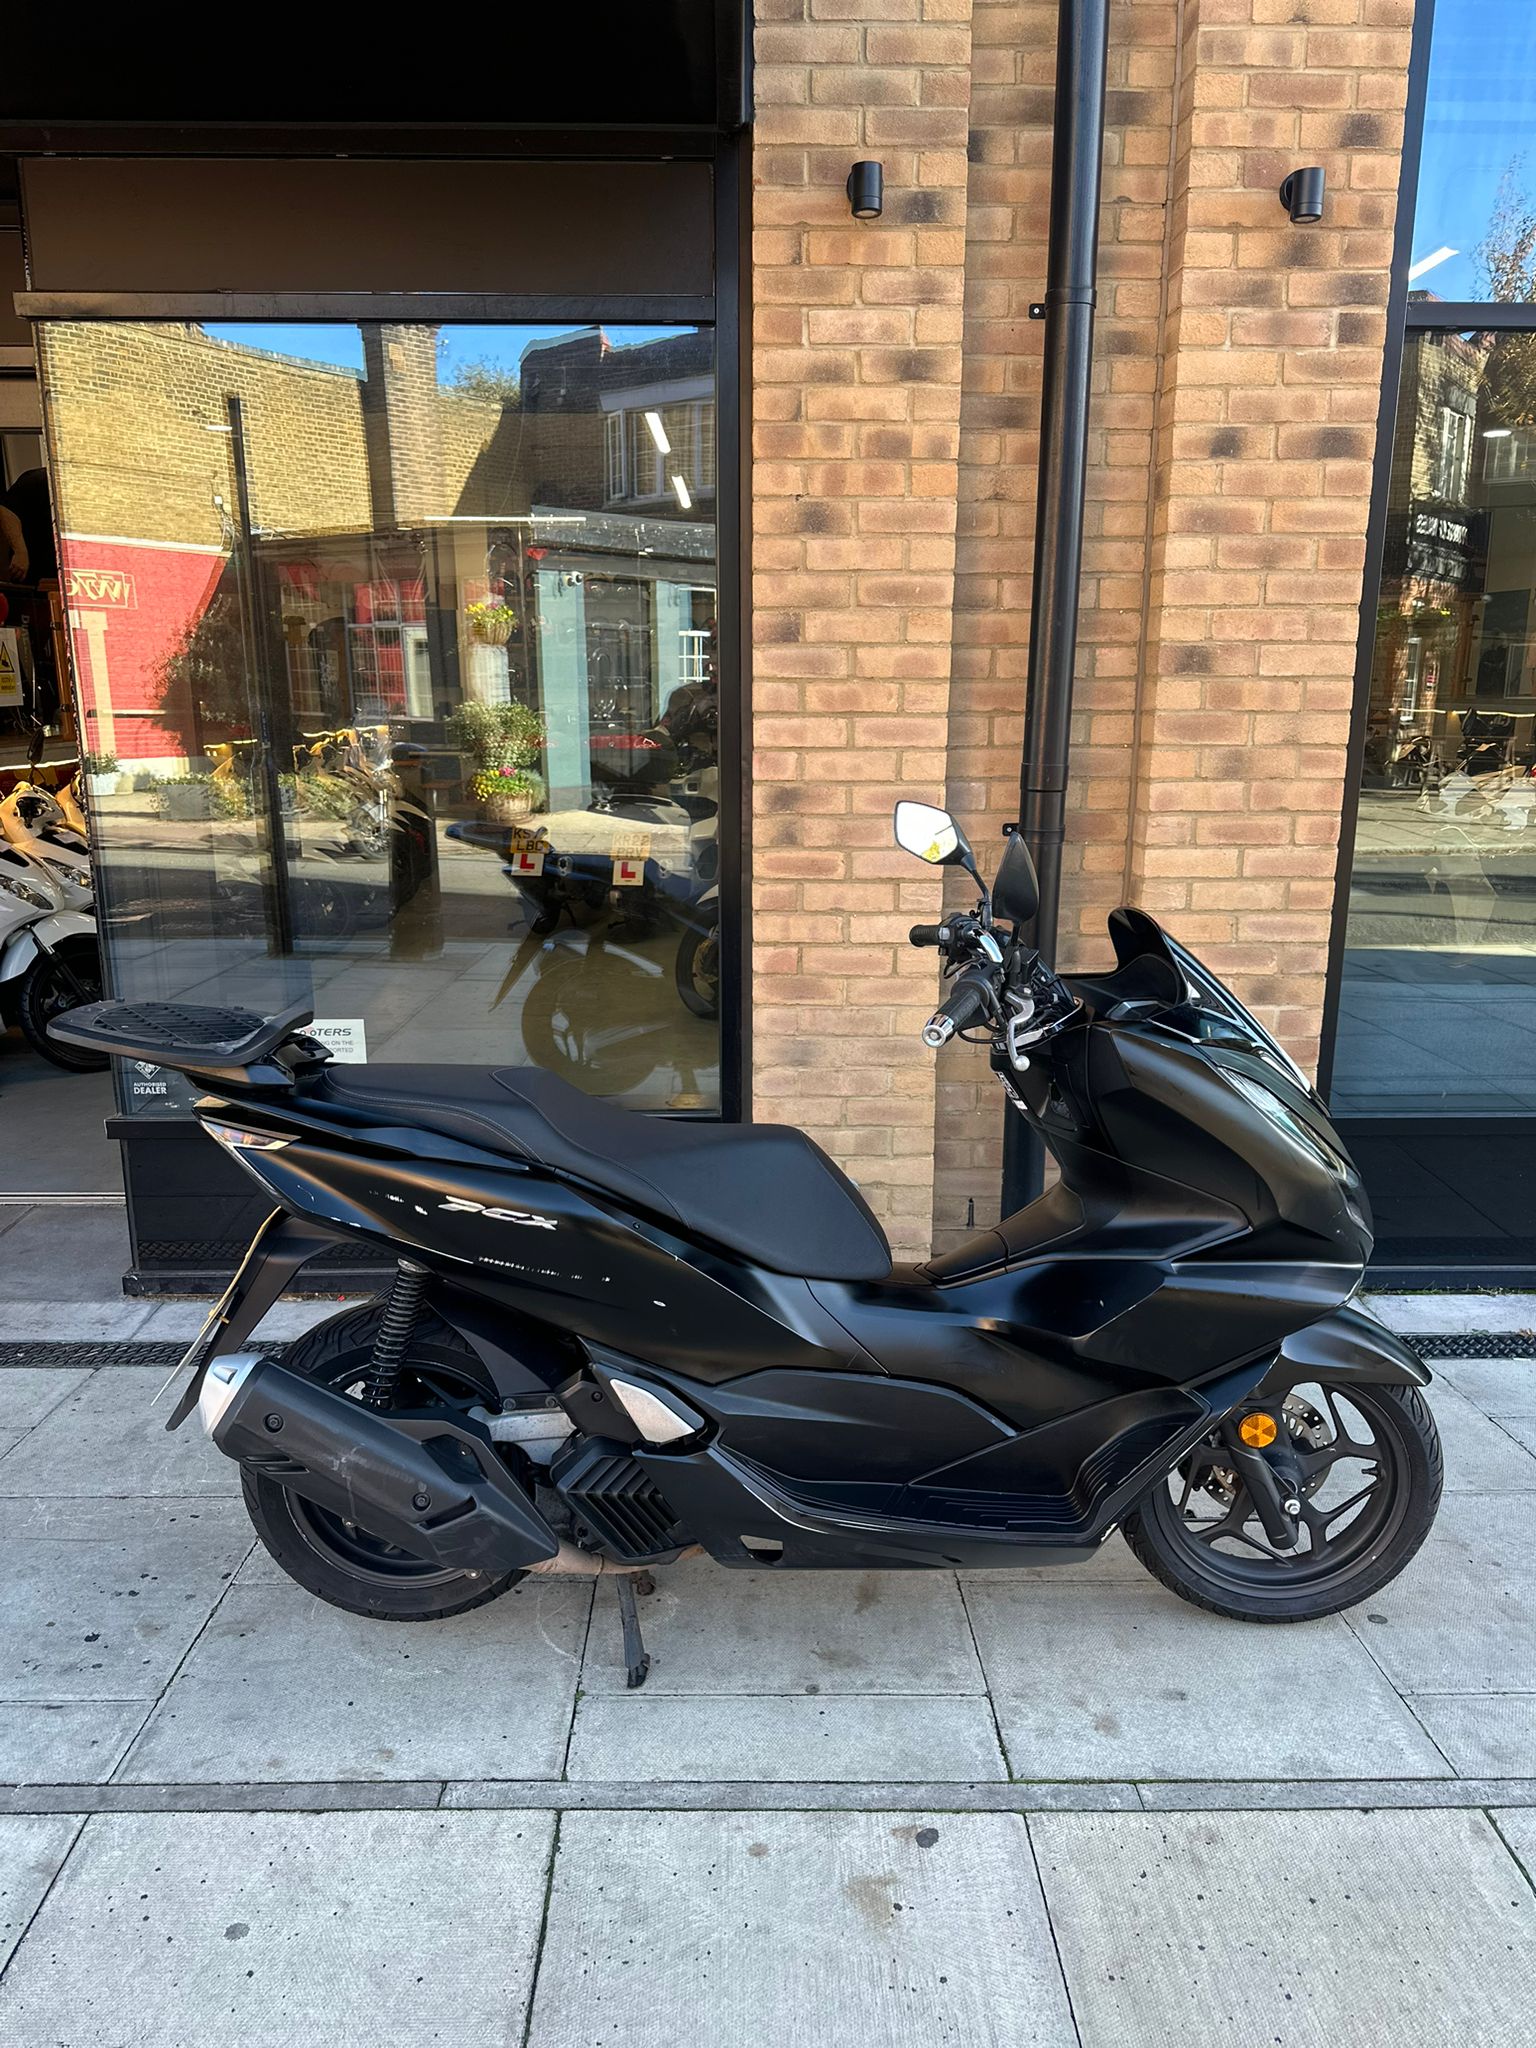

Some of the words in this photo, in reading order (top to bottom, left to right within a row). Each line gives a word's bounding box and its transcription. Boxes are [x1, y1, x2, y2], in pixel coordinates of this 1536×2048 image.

[520, 853, 535, 870] L
[621, 861, 636, 879] L
[133, 1087, 168, 1095] DEALER
[437, 1195, 558, 1231] PCX
